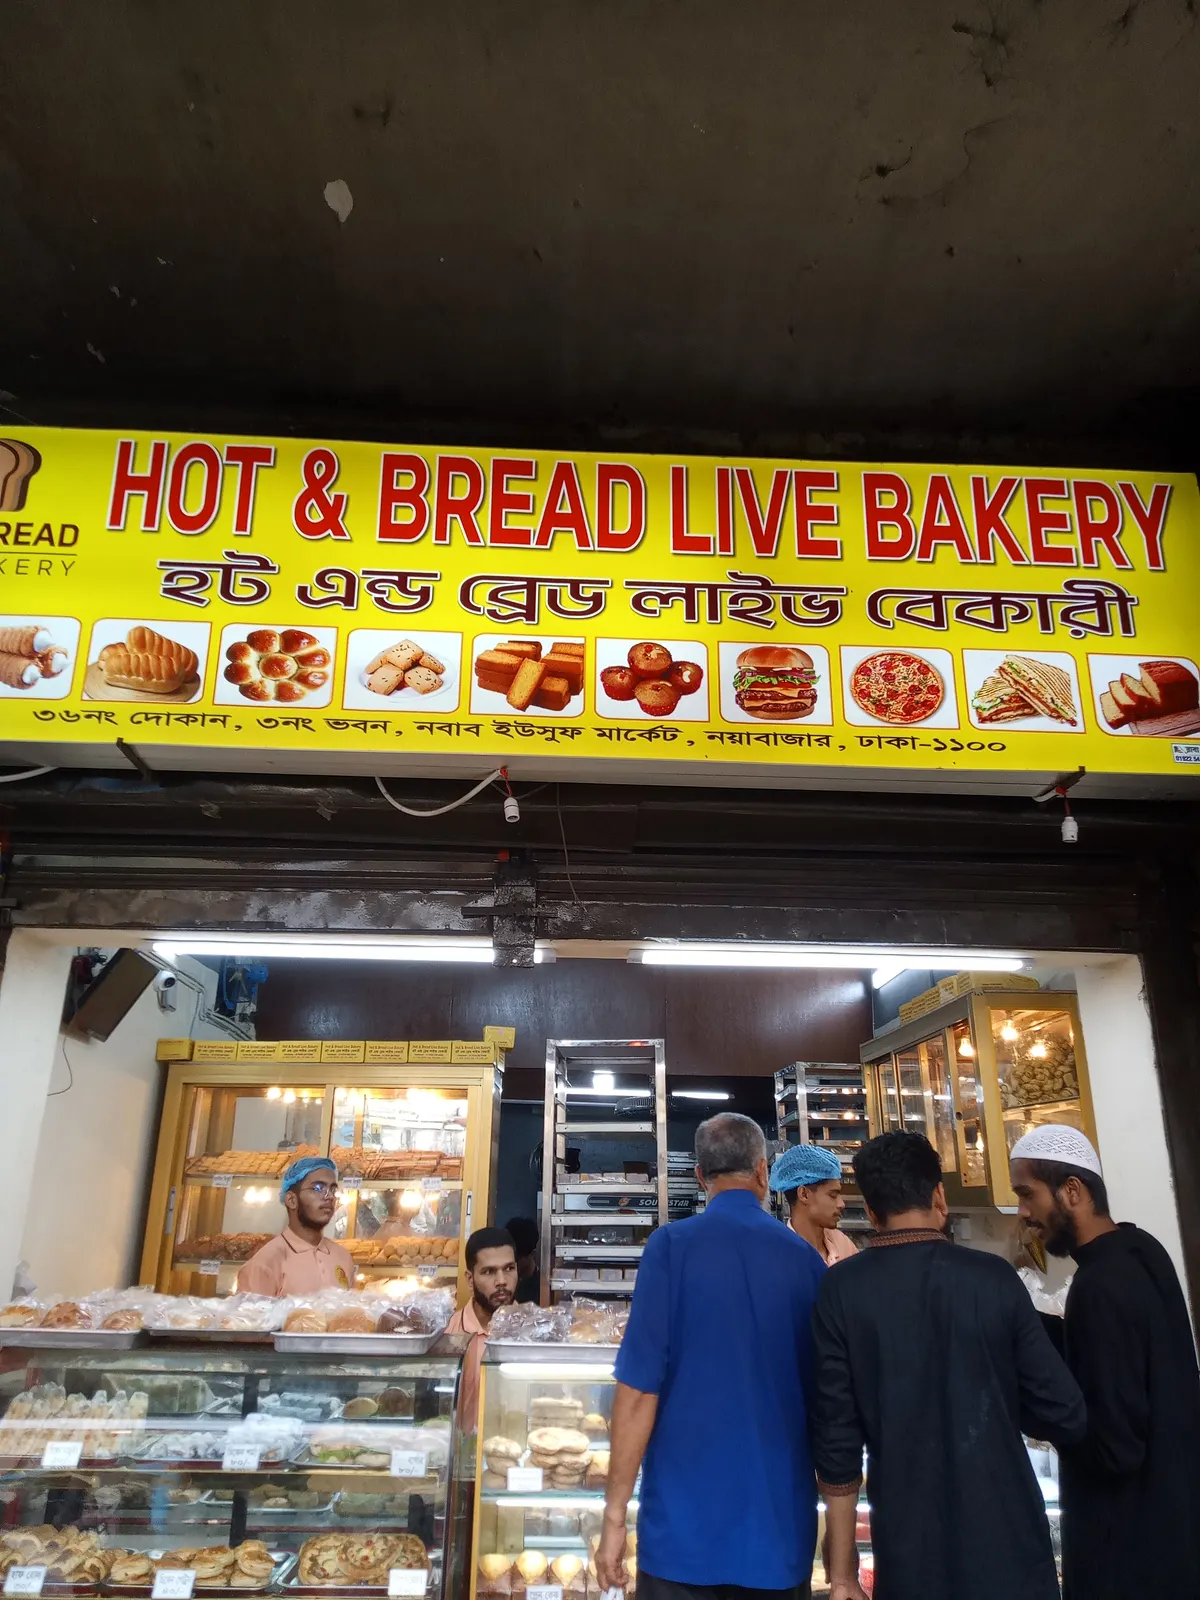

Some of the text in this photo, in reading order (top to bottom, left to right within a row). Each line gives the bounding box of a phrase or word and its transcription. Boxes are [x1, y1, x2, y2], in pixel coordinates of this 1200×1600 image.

[105, 440, 1173, 571] HOT & BREAD LIVE BAKERY
[157, 549, 1139, 639] হট এন্ড ব্রেড লাইভ বেকারী
[33, 710, 118, 725] ৩৬নং
[256, 716, 316, 732] ৩নং
[413, 721, 484, 738] নবাব
[492, 719, 585, 744] ইউসুফ
[855, 735, 1007, 751] ঢাকা-১১০০
[639, 1198, 690, 1207] SOUSTAR
